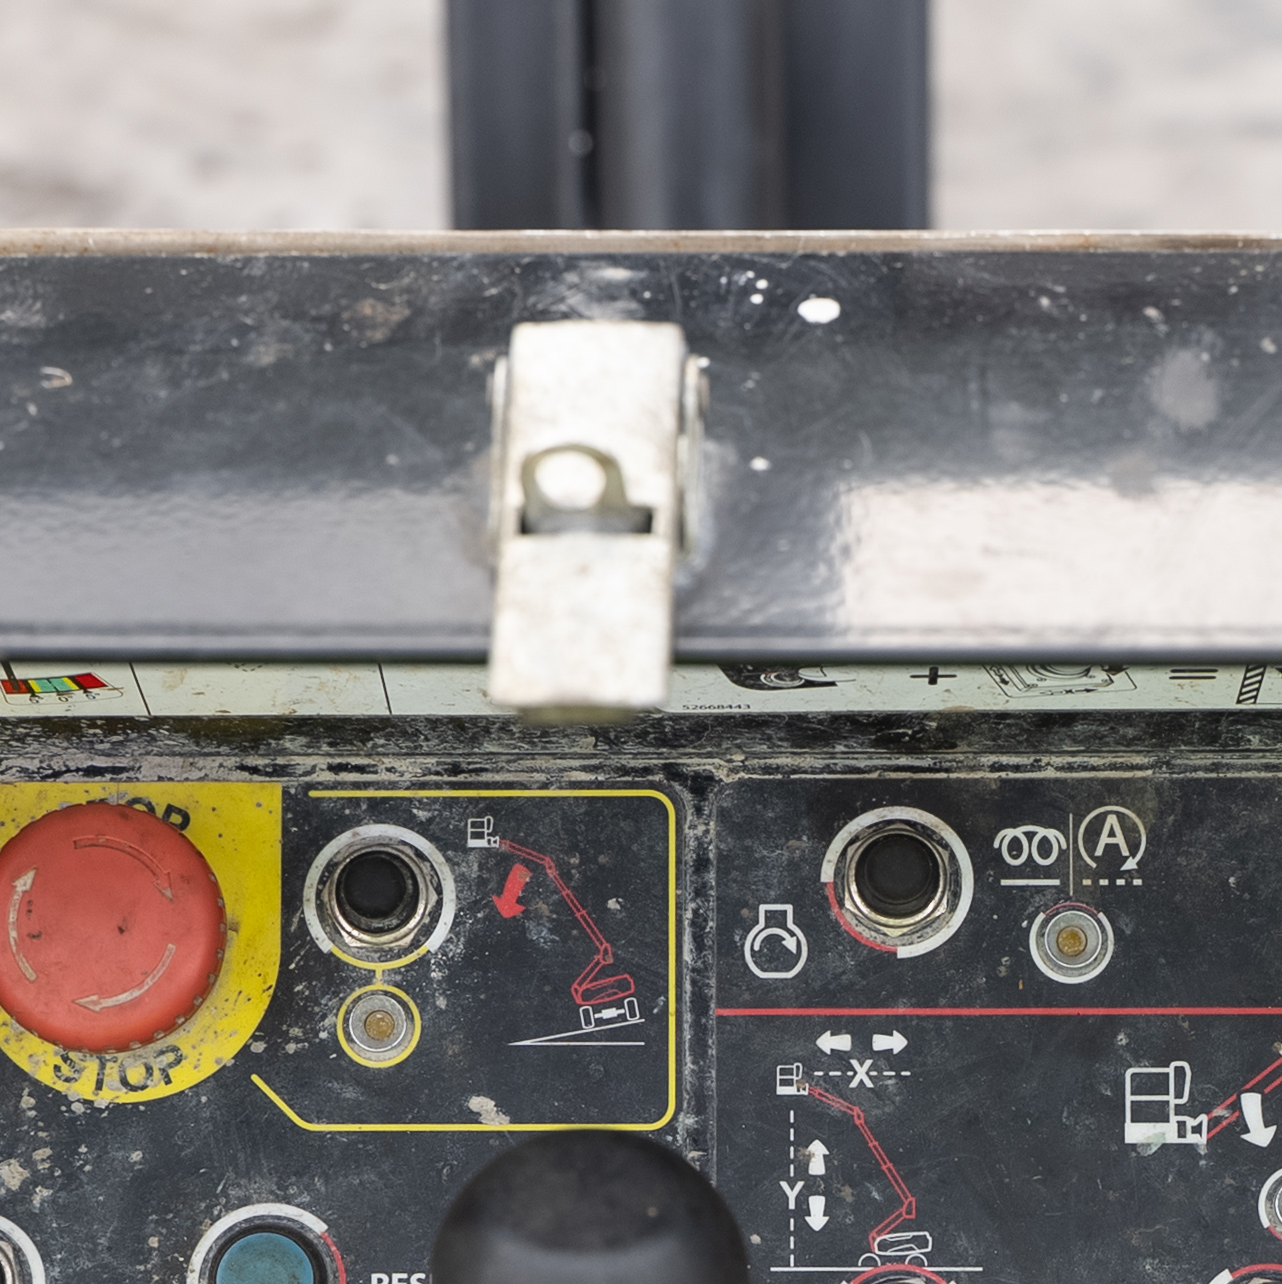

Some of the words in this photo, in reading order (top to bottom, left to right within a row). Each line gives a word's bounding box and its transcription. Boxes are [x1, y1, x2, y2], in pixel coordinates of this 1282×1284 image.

[682, 703, 752, 711] 52668443
[53, 1043, 183, 1093] STOP
[848, 1059, 875, 1088] X
[779, 1181, 806, 1210] Y
